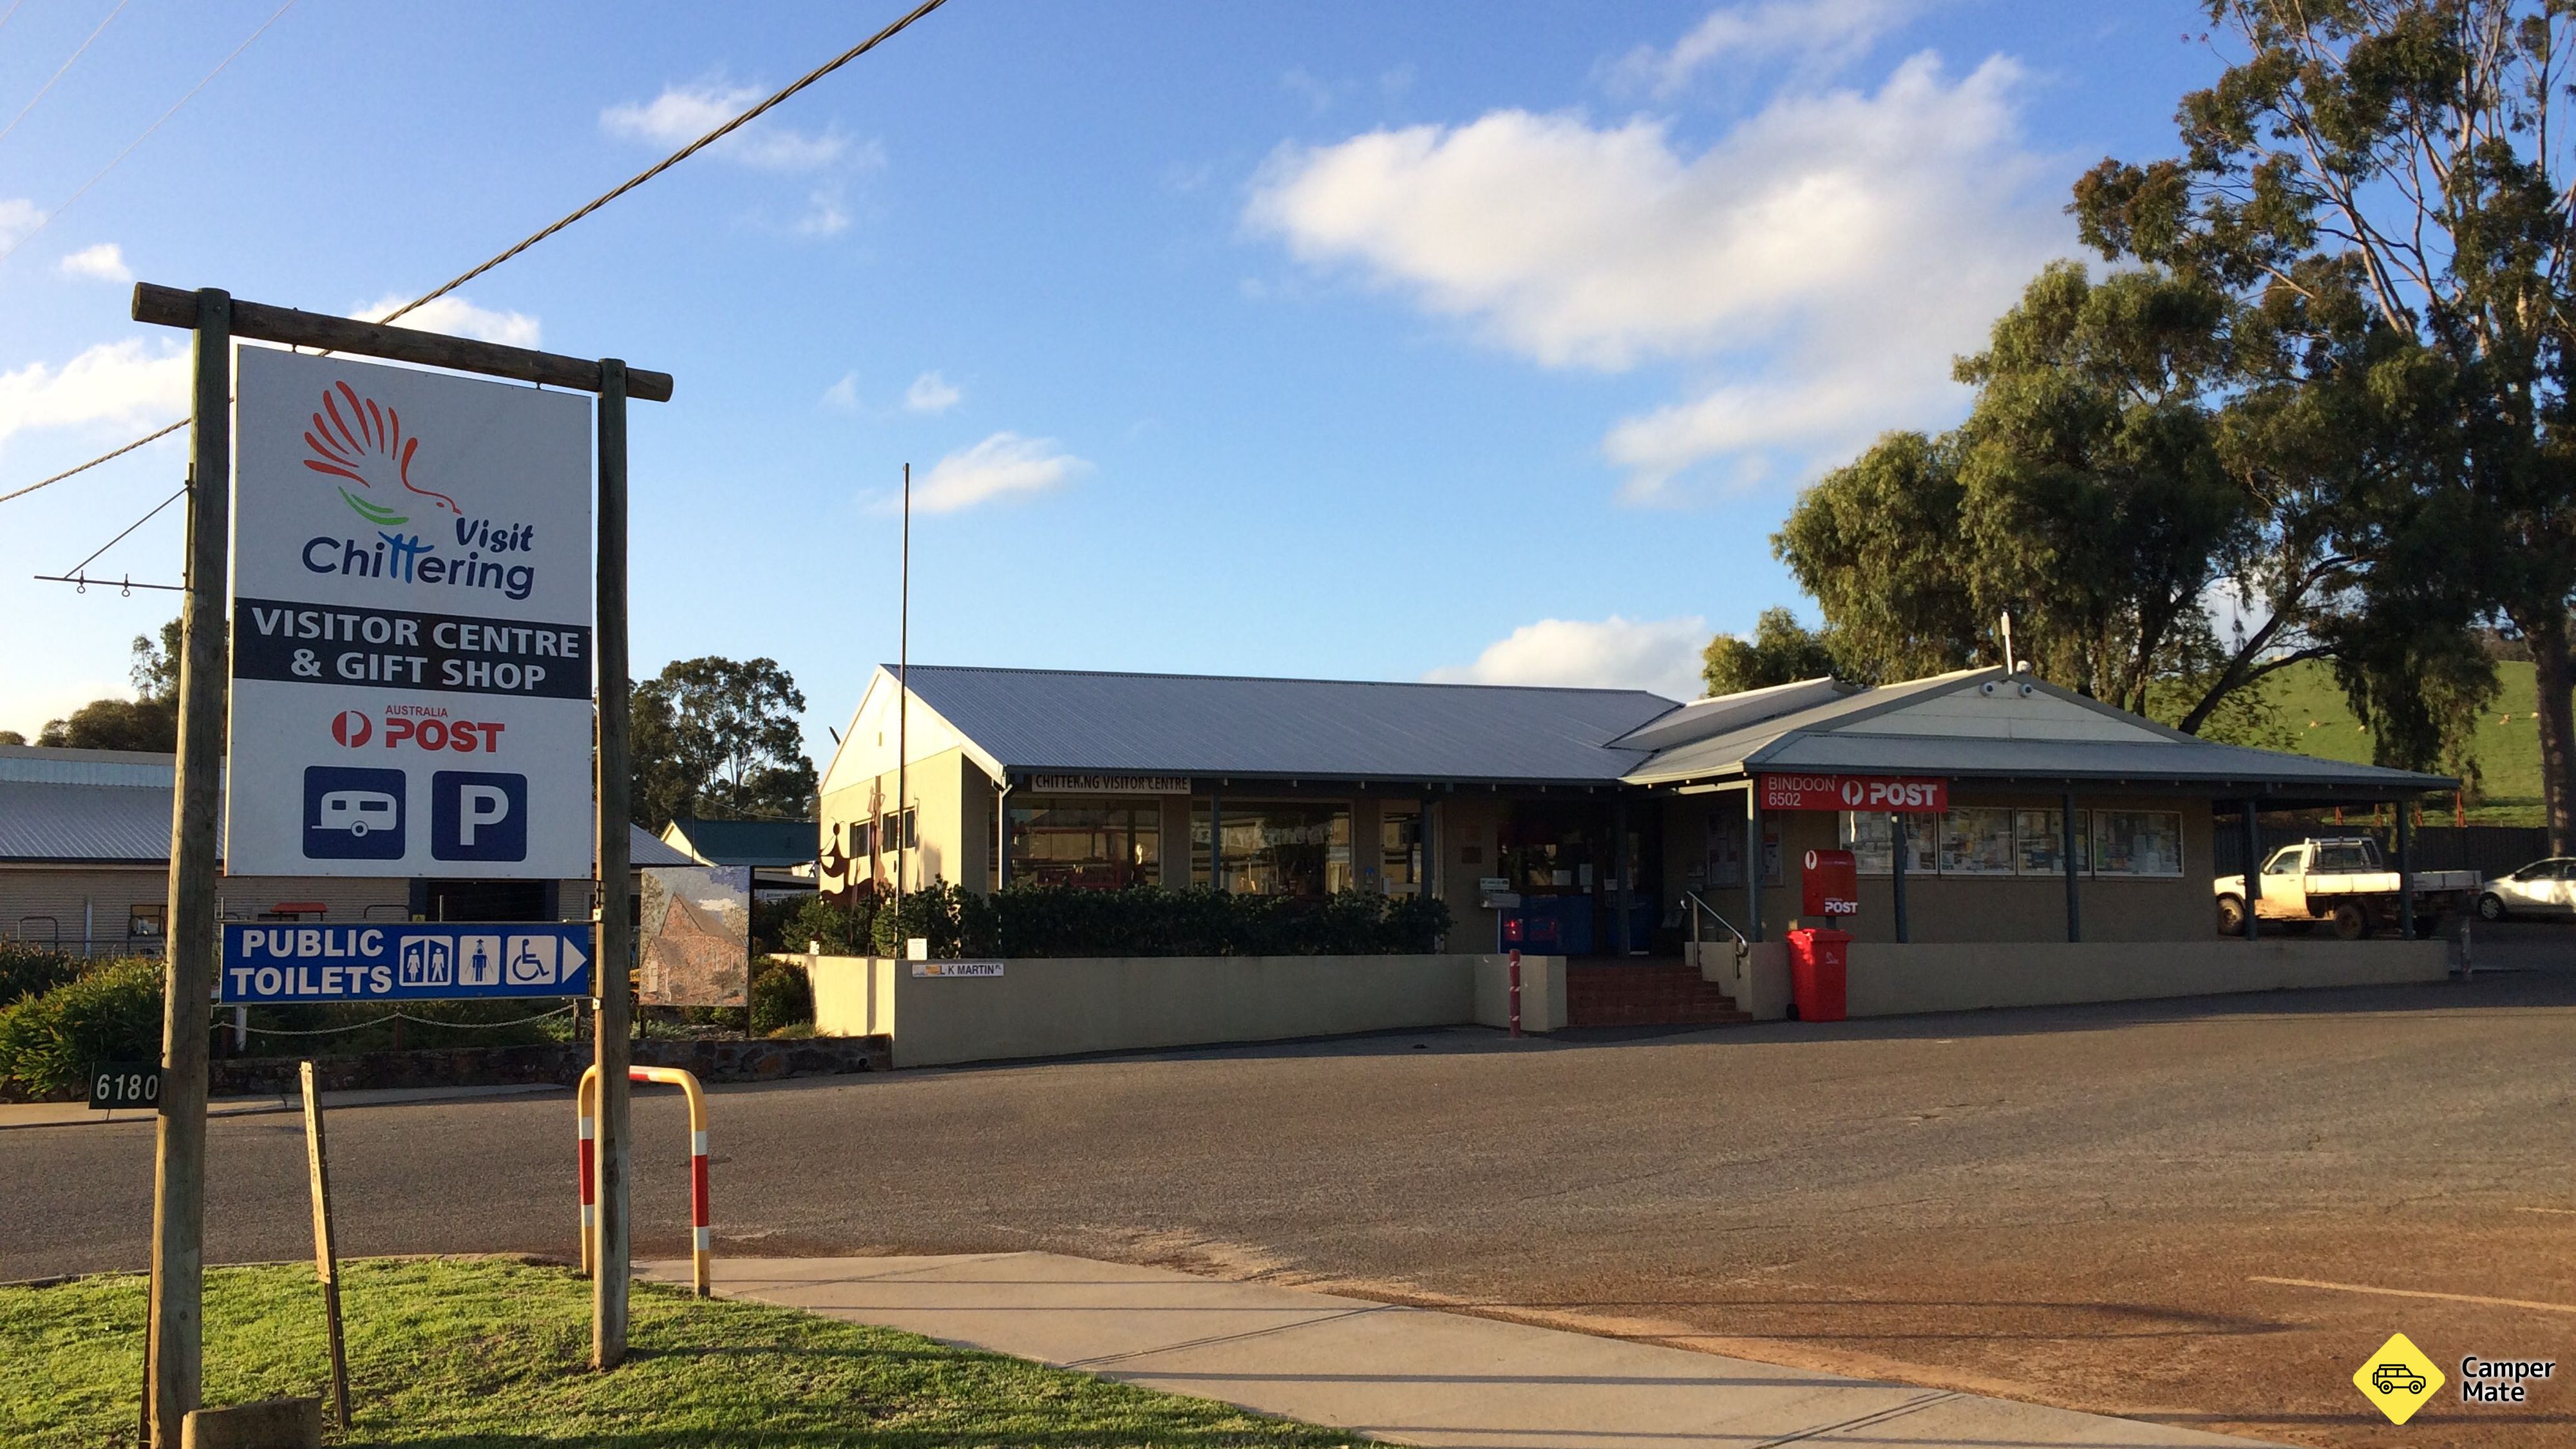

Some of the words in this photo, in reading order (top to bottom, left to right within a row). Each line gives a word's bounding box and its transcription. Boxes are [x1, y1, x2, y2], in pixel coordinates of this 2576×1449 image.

[456, 517, 535, 552] Visit
[302, 531, 535, 600] Chittering
[252, 607, 420, 647] VISITOR
[432, 622, 580, 659] CENTRE
[290, 648, 322, 678] &
[336, 652, 428, 683] GIFT
[442, 659, 546, 690] SHOP
[385, 705, 448, 717] AUSTRALIA
[385, 717, 506, 753] POST
[1103, 775, 1144, 790] VISITOR
[1148, 776, 1188, 790] CENTRE
[1768, 777, 1835, 792] BINDOON
[1870, 783, 1938, 806] POST
[1768, 793, 1801, 806] 6502
[460, 784, 509, 846] P
[1824, 902, 1858, 913] POST
[242, 929, 384, 958] PUBLIC
[230, 966, 393, 996] TOILETS
[948, 965, 955, 974] K
[958, 965, 994, 975] MARTIN
[97, 1074, 158, 1101] 6180
